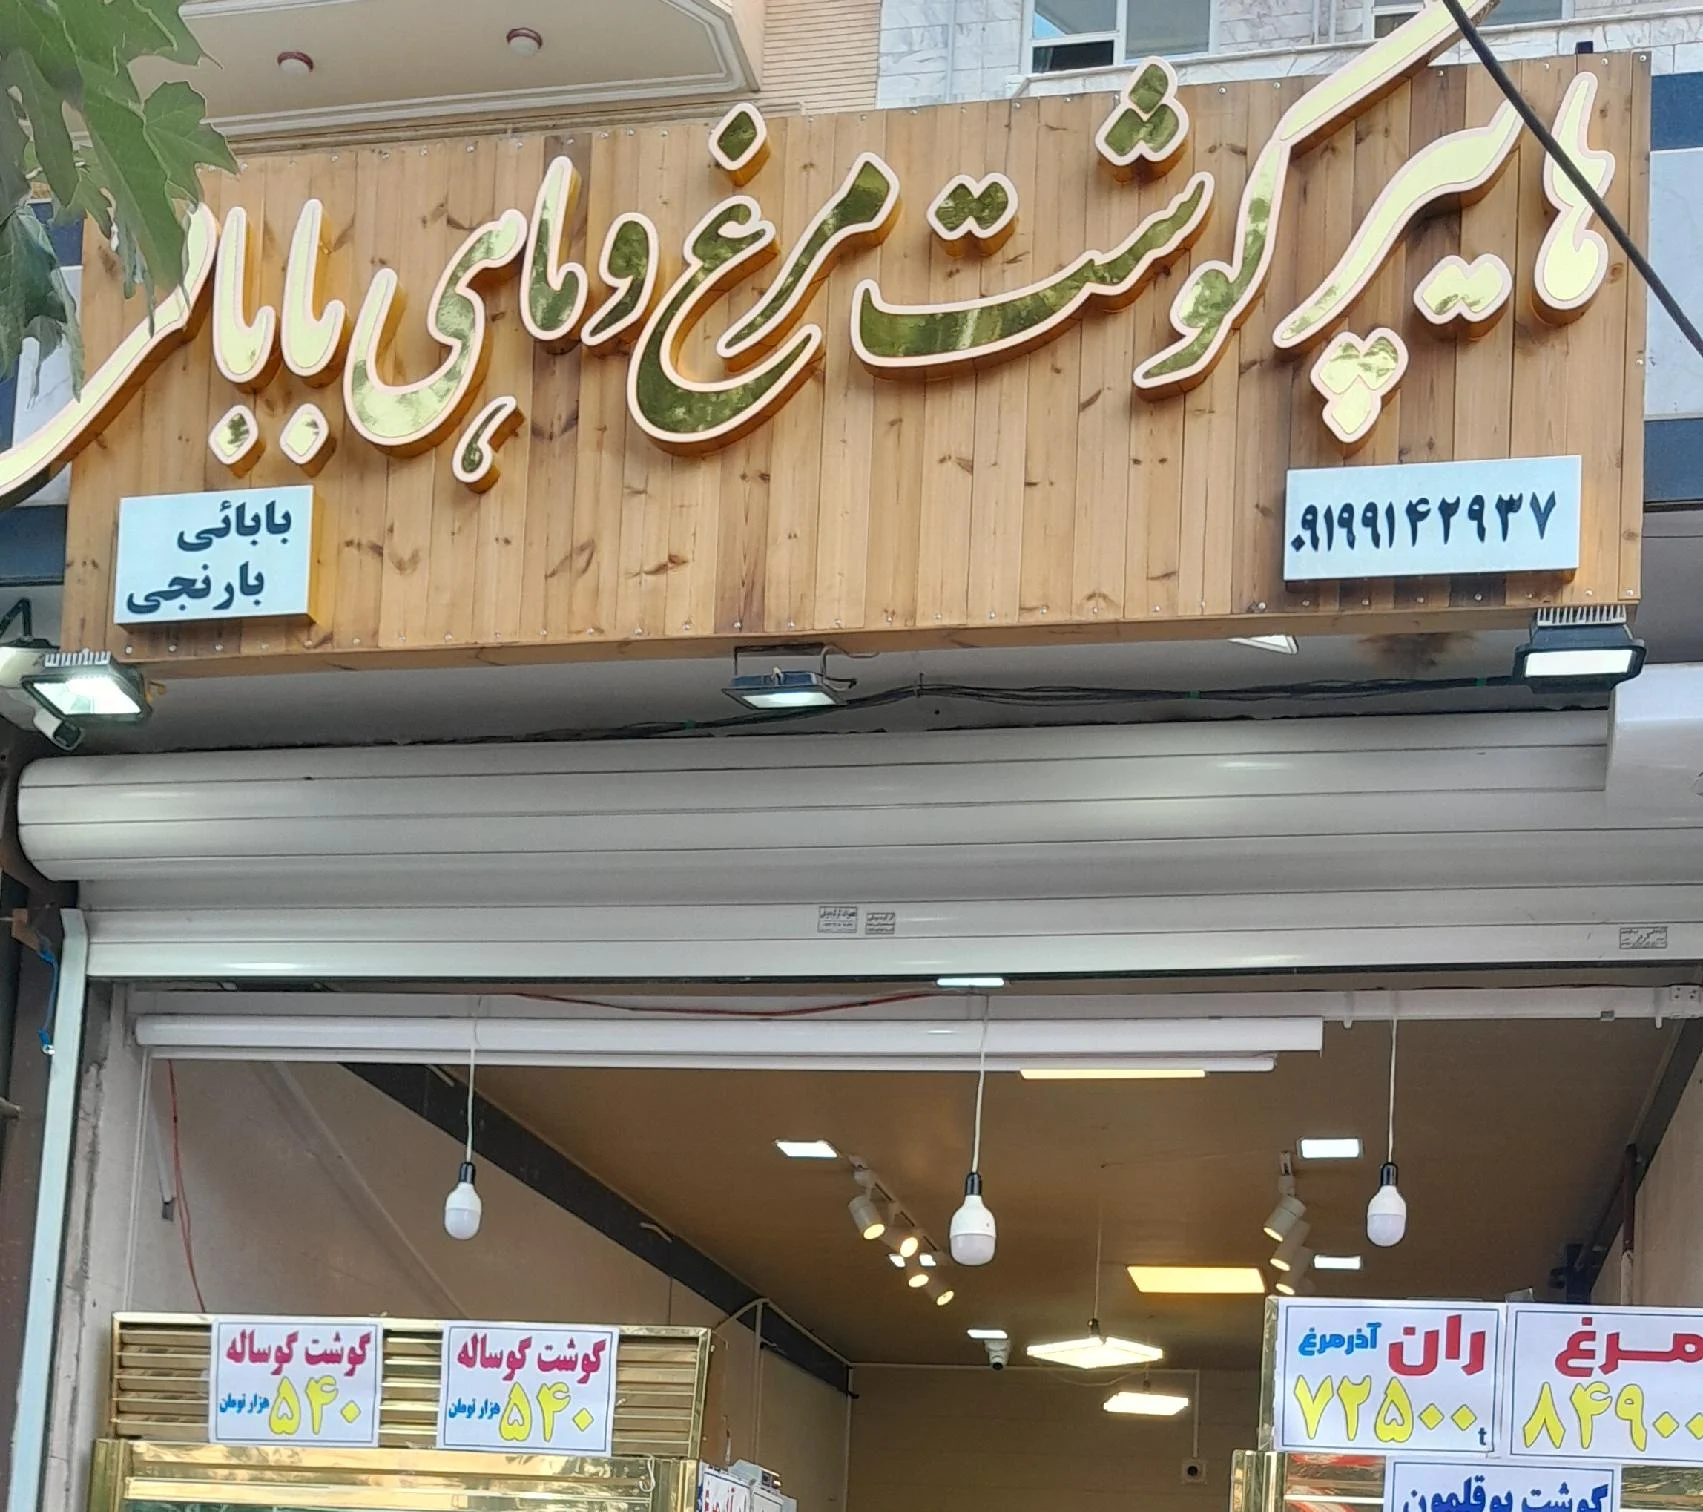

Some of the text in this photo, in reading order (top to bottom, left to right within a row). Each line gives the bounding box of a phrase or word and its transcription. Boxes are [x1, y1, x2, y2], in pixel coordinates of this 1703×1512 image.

[850, 0, 1500, 391] گوشت
[626, 102, 899, 446] مرغ
[1289, 488, 1558, 558] ۰۹۱۹۹۱۴۲۹۳۷
[125, 560, 266, 615] بارنجی
[225, 1328, 372, 1377] گوشت گوساله
[456, 1332, 607, 1384] گوشت گوساله
[1387, 1313, 1487, 1377] ران
[1554, 1316, 1703, 1378] مرغ
[268, 1375, 363, 1436] ۵۴۰
[498, 1381, 595, 1442] ۵۴۰
[1293, 1374, 1478, 1444] ۷۲۵۰۰
